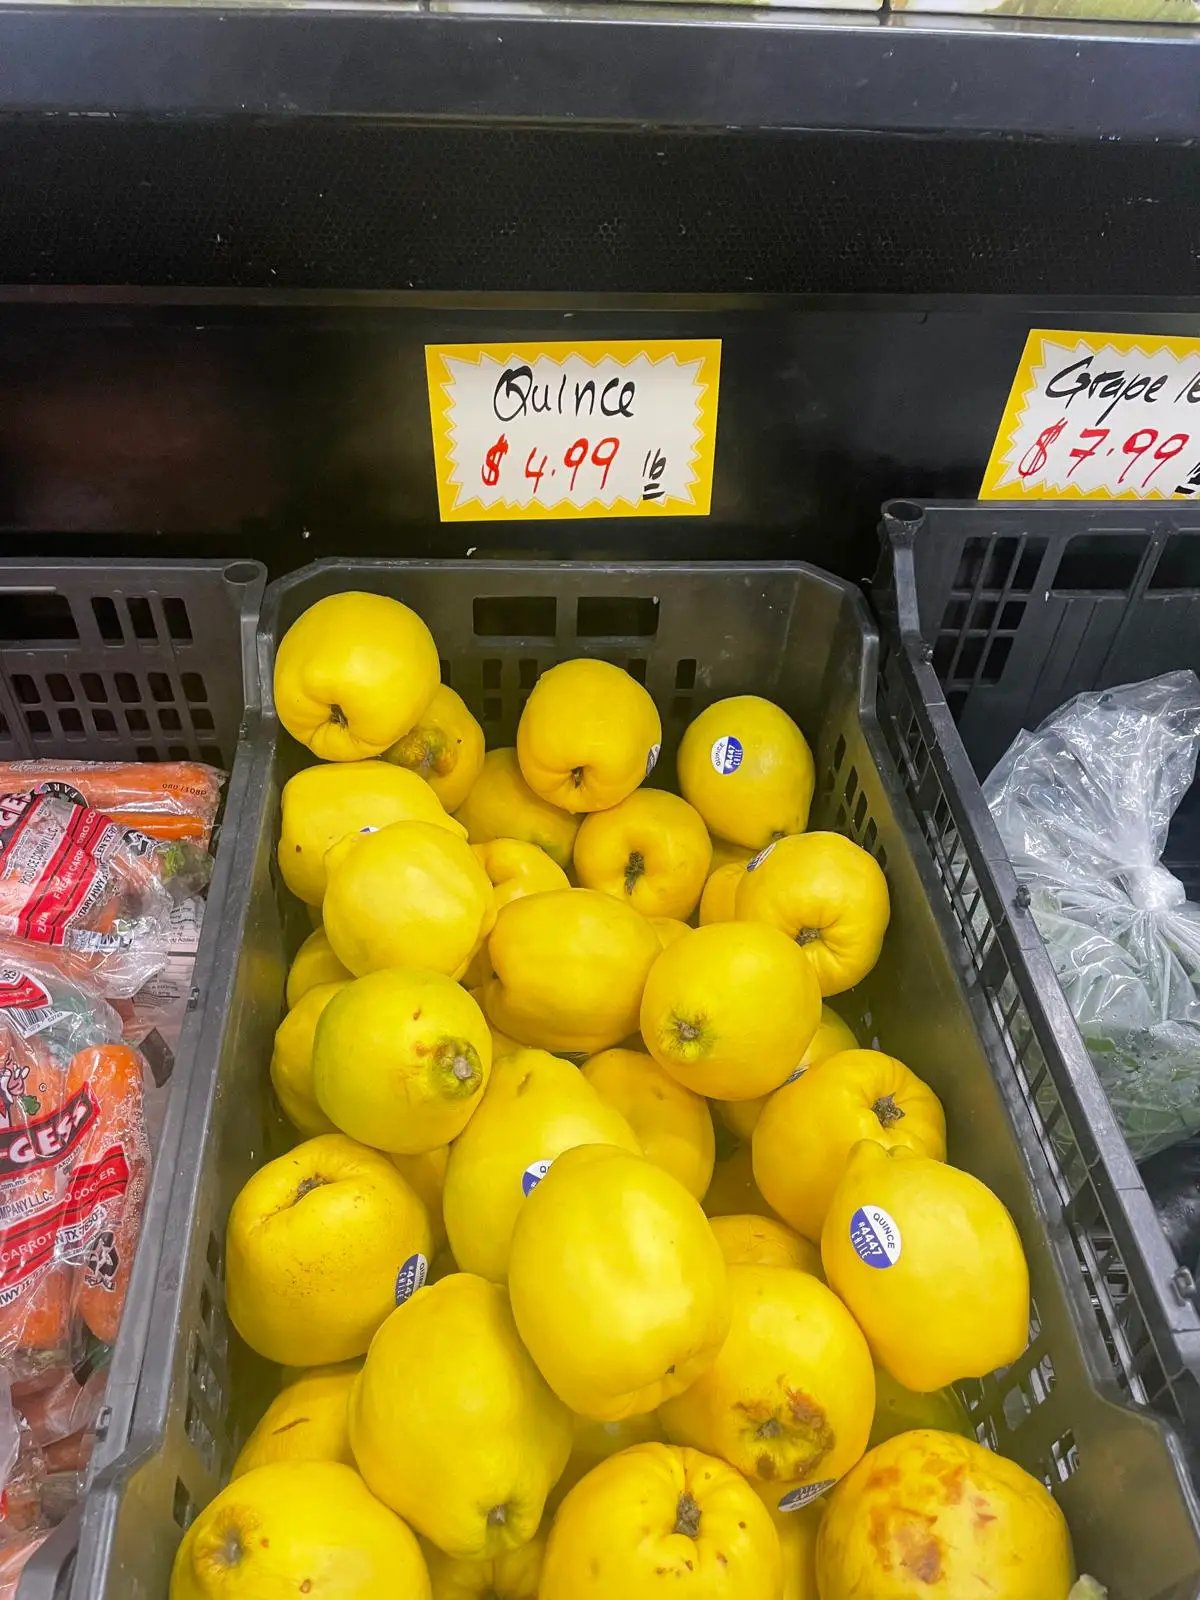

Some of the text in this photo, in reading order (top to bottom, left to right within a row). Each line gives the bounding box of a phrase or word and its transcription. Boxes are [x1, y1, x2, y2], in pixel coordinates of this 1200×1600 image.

[493, 365, 636, 422] Quince
[1045, 356, 1168, 427] Grape
[69, 848, 86, 872] CARR
[2, 1231, 53, 1262] CARROT
[851, 1230, 871, 1259] CHILE
[873, 1212, 895, 1250] QUINCE
